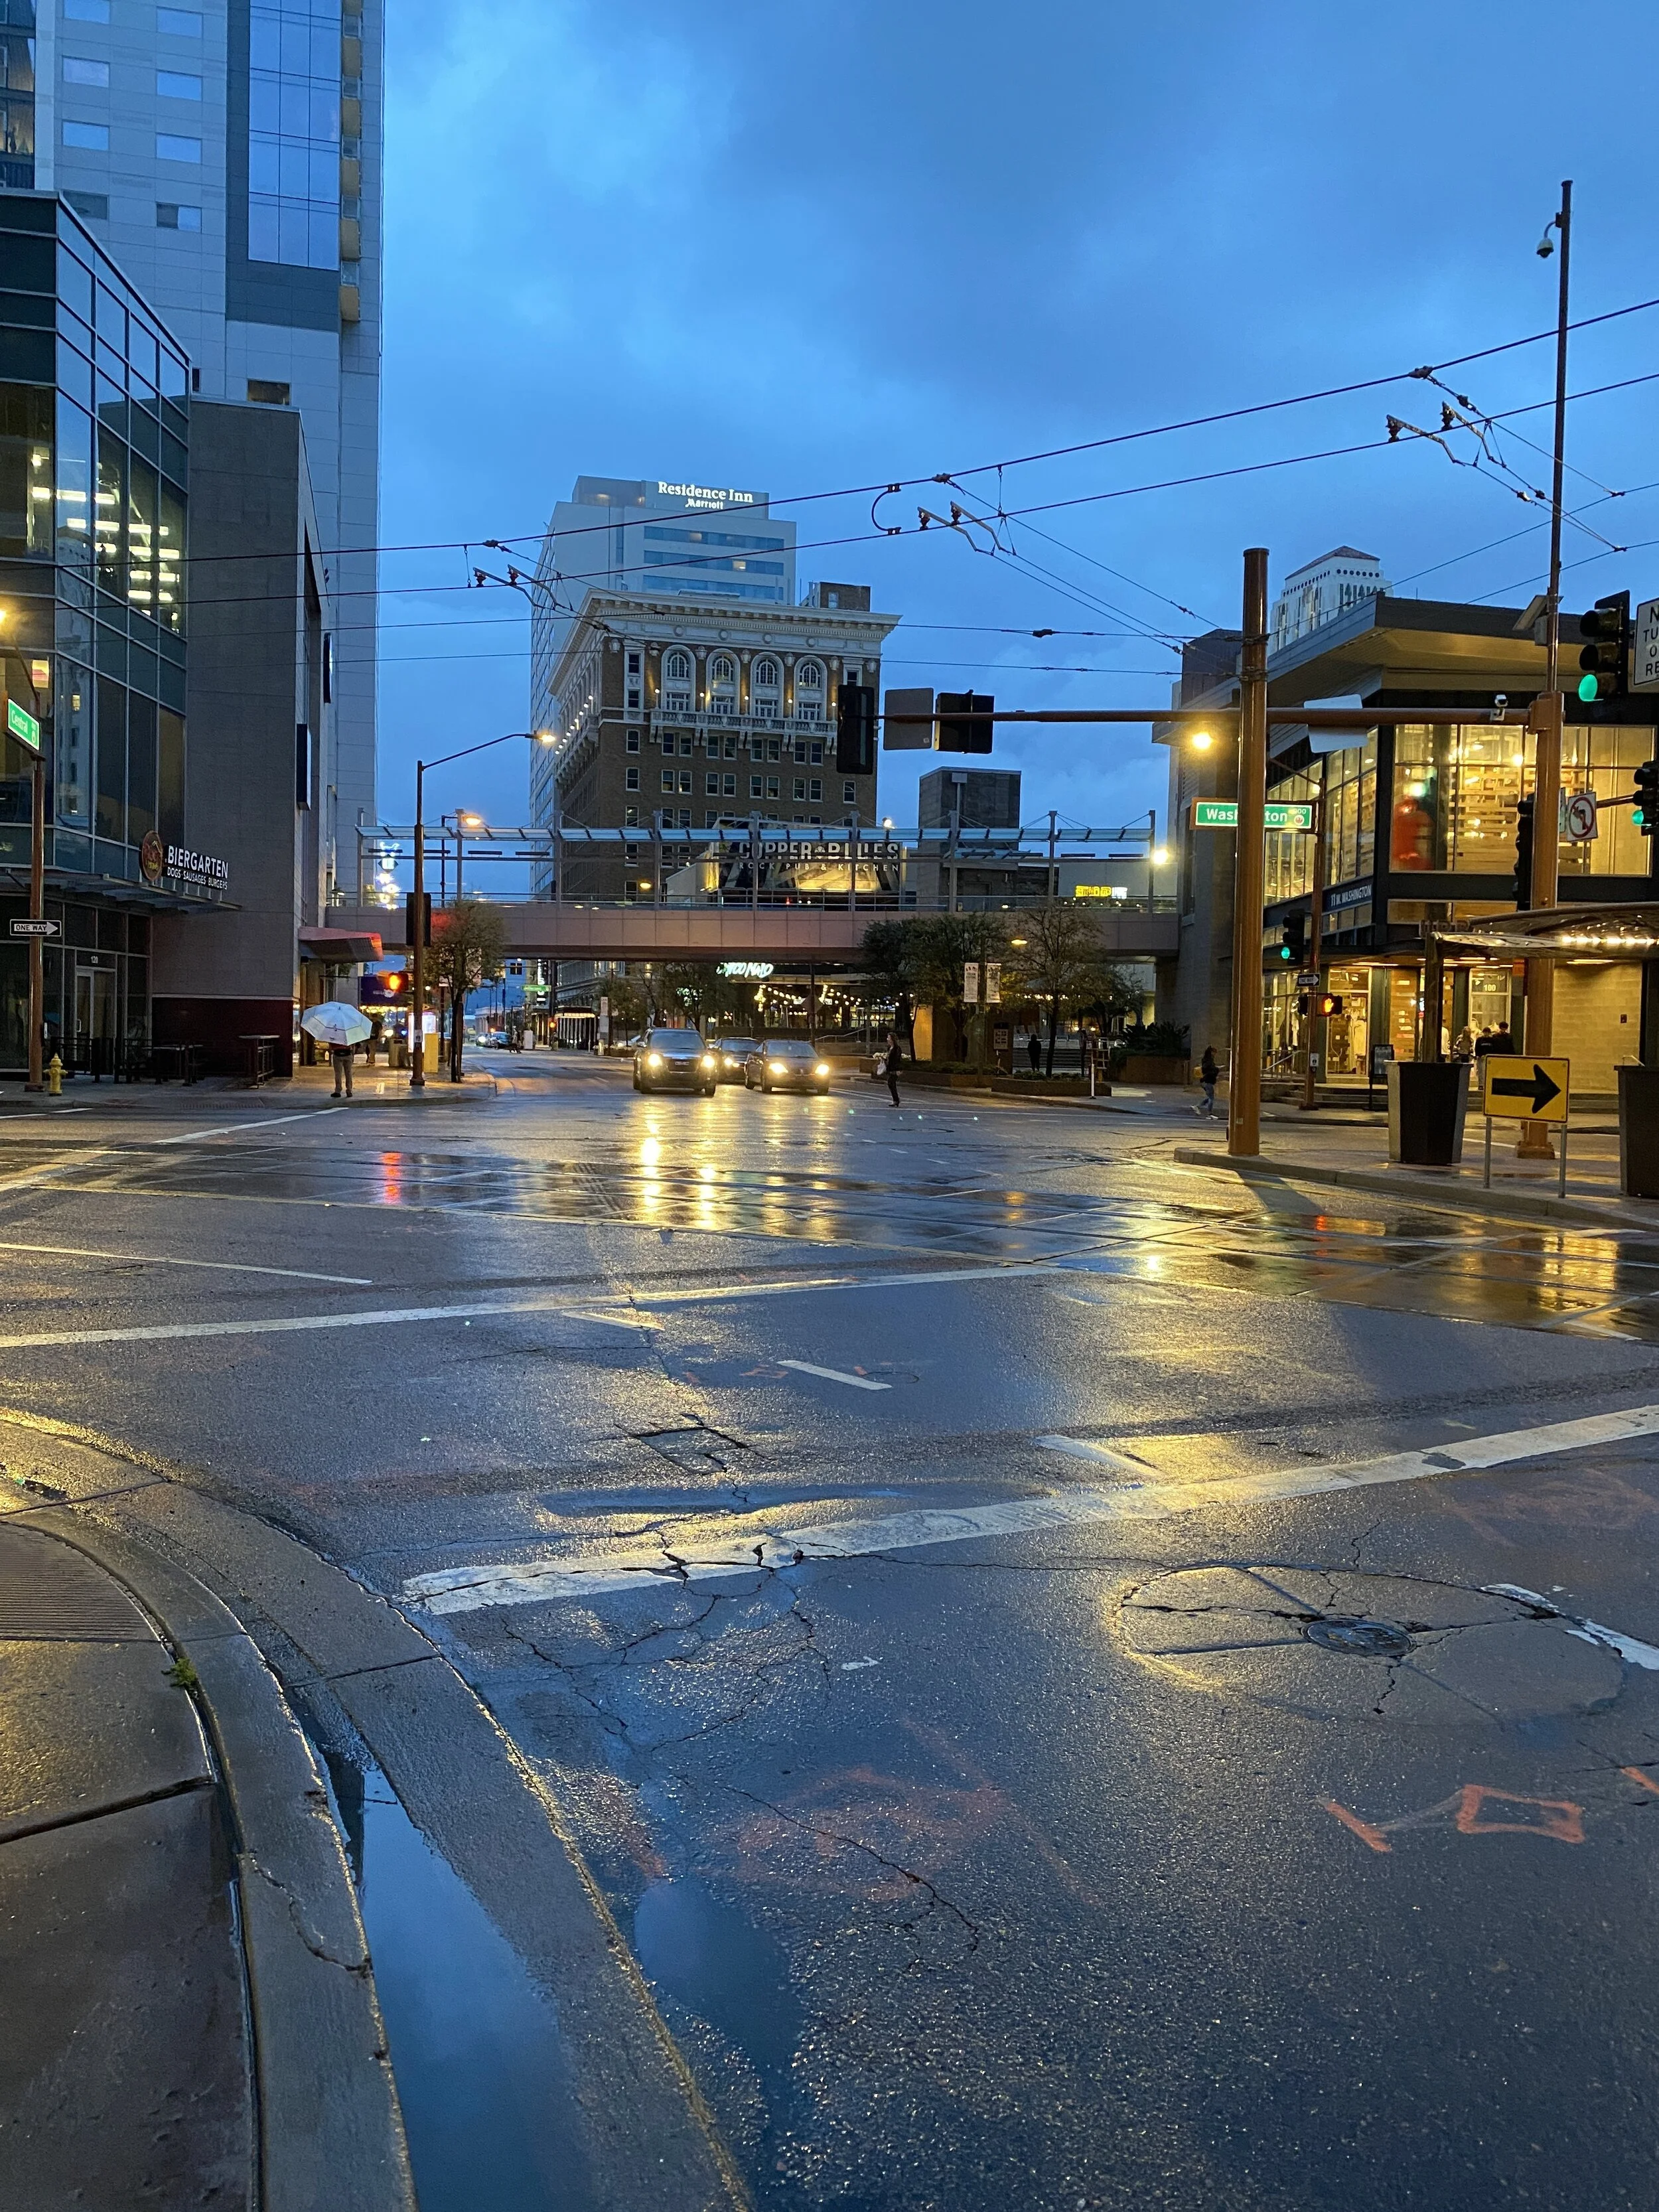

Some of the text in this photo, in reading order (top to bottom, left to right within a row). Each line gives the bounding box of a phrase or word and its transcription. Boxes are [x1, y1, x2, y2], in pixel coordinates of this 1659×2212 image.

[658, 481, 753, 502] Residence Inn
[685, 498, 723, 509] Marriott
[1650, 607, 1659, 623] N
[1643, 627, 1659, 642] TU
[1650, 644, 1657, 657] O
[1646, 660, 1659, 676] RE
[739, 842, 899, 860] COPPER BLUES
[168, 845, 228, 879] BIERGARTEN
[167, 867, 181, 879] DOGS
[183, 871, 206, 885] SAUSAGES
[1342, 884, 1372, 903] WASHINGTON
